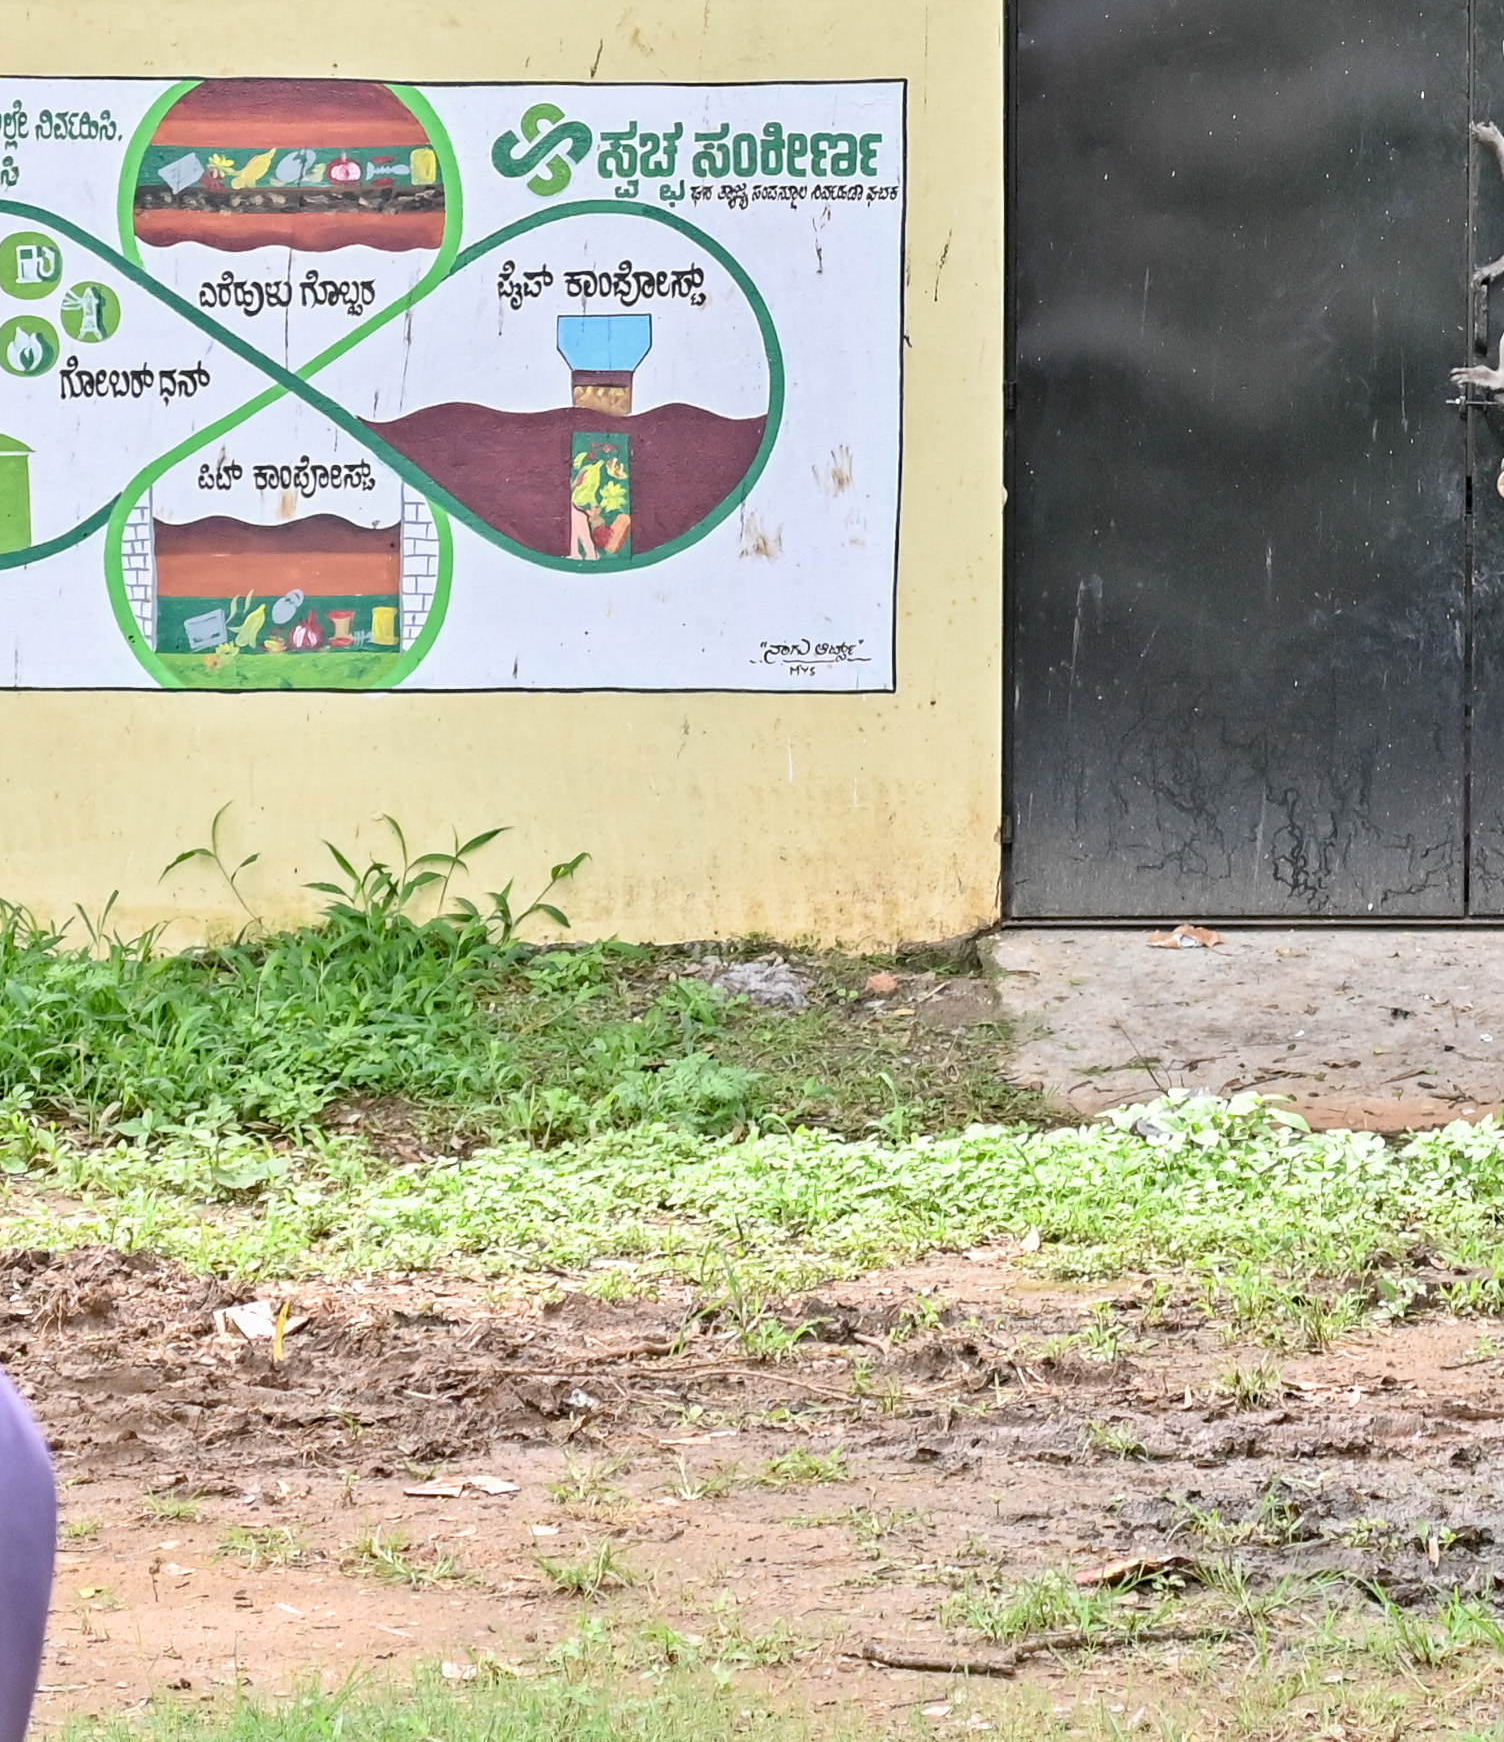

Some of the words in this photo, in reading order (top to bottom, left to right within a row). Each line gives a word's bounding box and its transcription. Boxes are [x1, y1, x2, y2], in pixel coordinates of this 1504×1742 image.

[692, 121, 883, 179] ಸಂಕೀರ್ಣ
[199, 270, 293, 317] ಎರೆಹುಳು
[299, 269, 376, 316] ಗೊಬ್ಬರ
[497, 260, 554, 310] ಪೈಪ್
[563, 260, 707, 307] ಕಾಂಪೋಸ್ಟ್
[59, 355, 154, 400] ಗೋಬರ್
[158, 360, 211, 407] ಧನ್
[198, 459, 243, 491] ಪಿಟ್
[252, 455, 376, 499] ಕಾಂಪೋಸ್ಟ್
